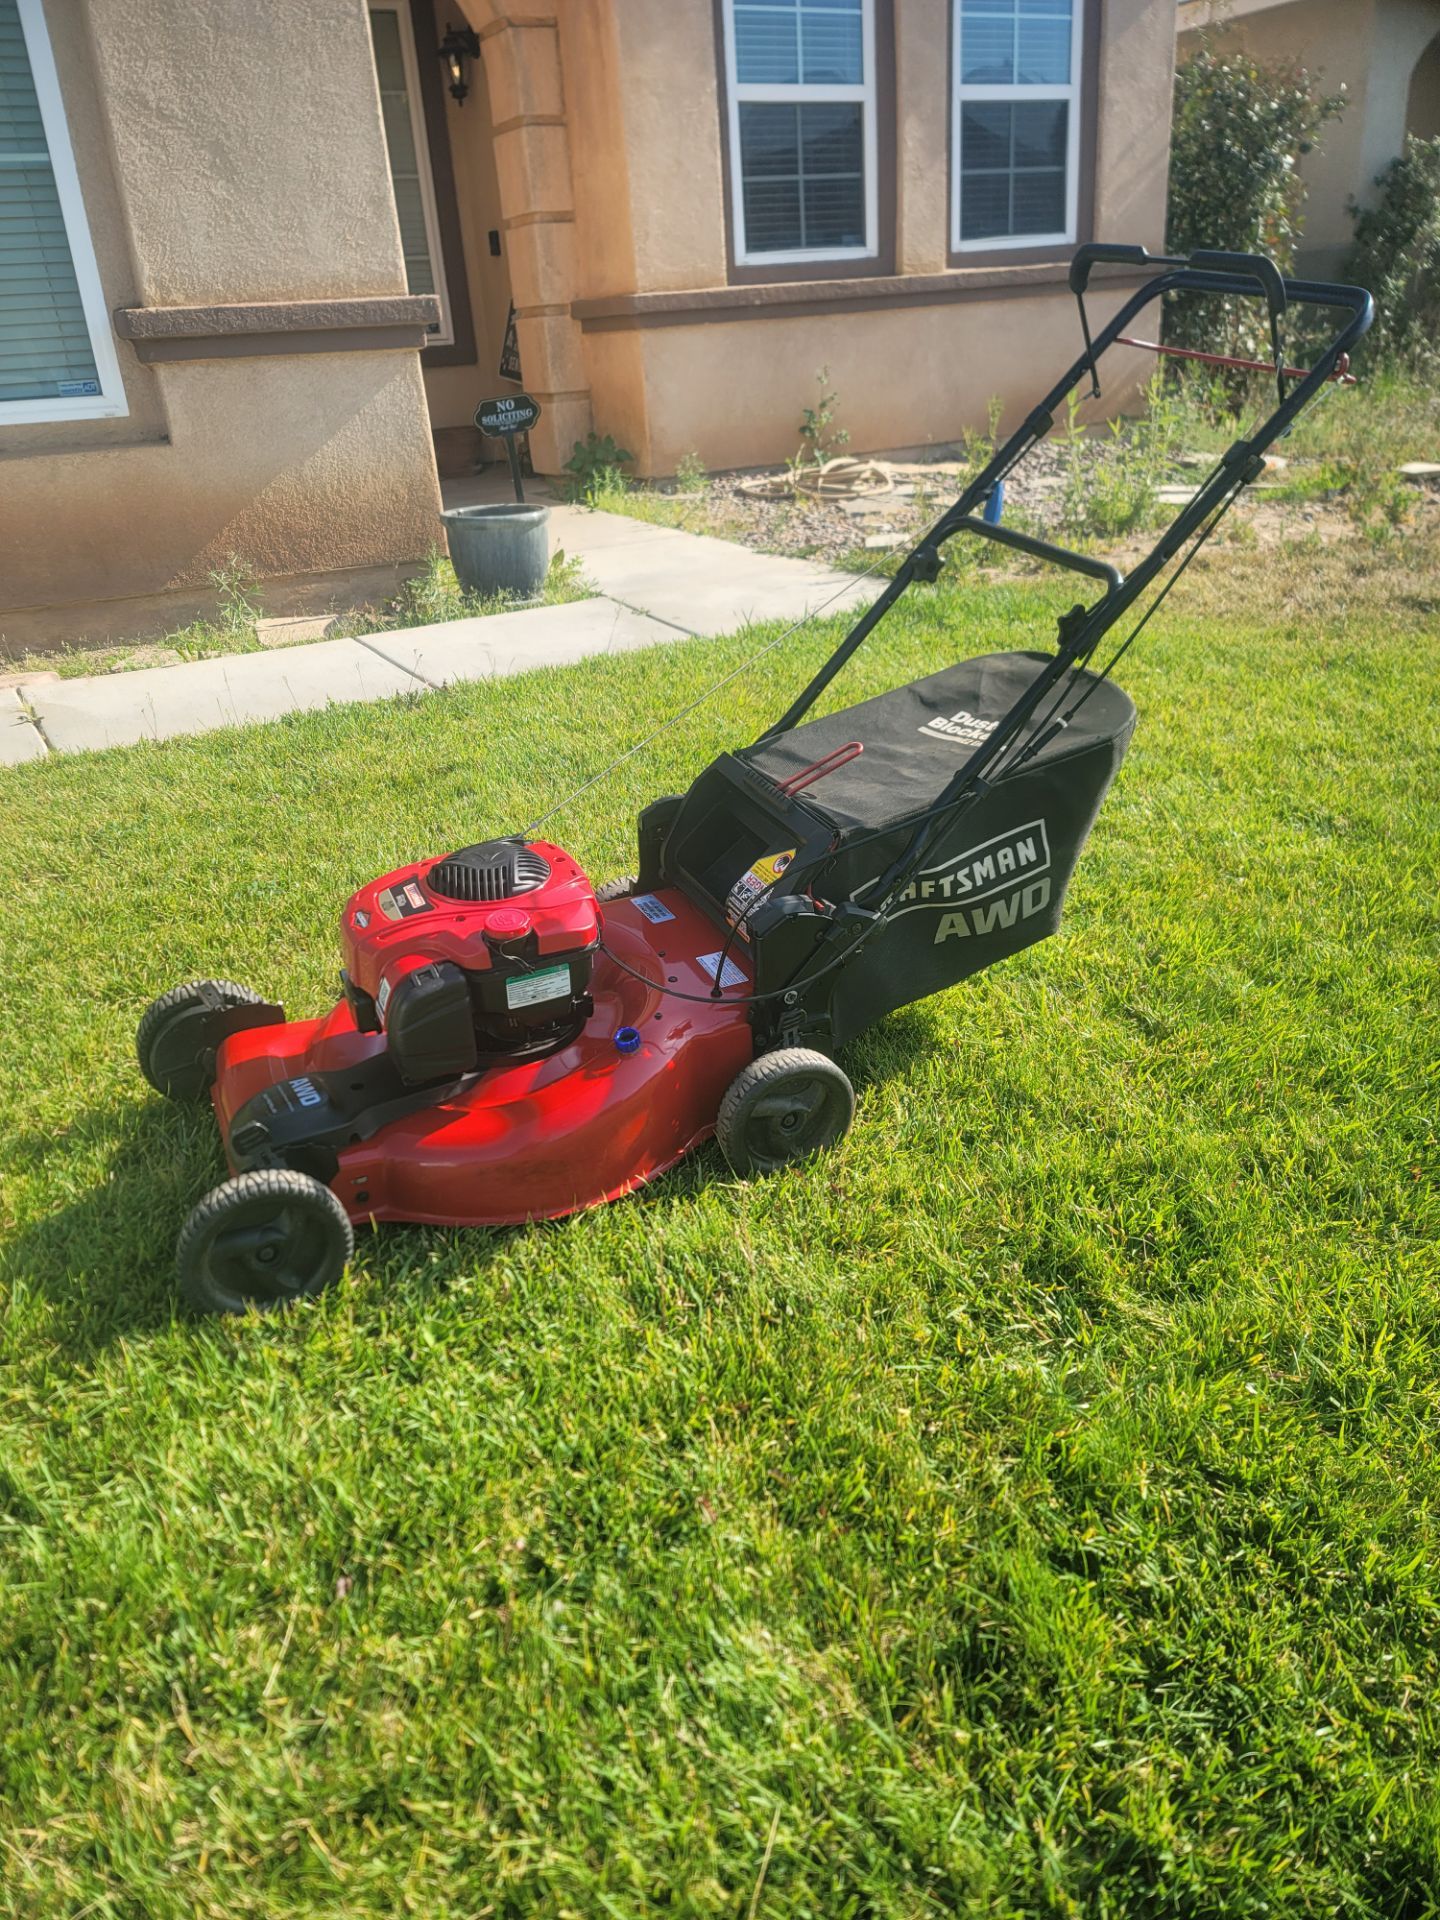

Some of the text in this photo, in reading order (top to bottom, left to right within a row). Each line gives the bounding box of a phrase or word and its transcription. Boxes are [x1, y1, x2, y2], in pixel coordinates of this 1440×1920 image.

[481, 408, 533, 425] SOLICITING
[496, 399, 515, 412] NO
[927, 716, 991, 740] Blocke
[934, 877, 1051, 945] AWD
[289, 1077, 321, 1107] AWD
